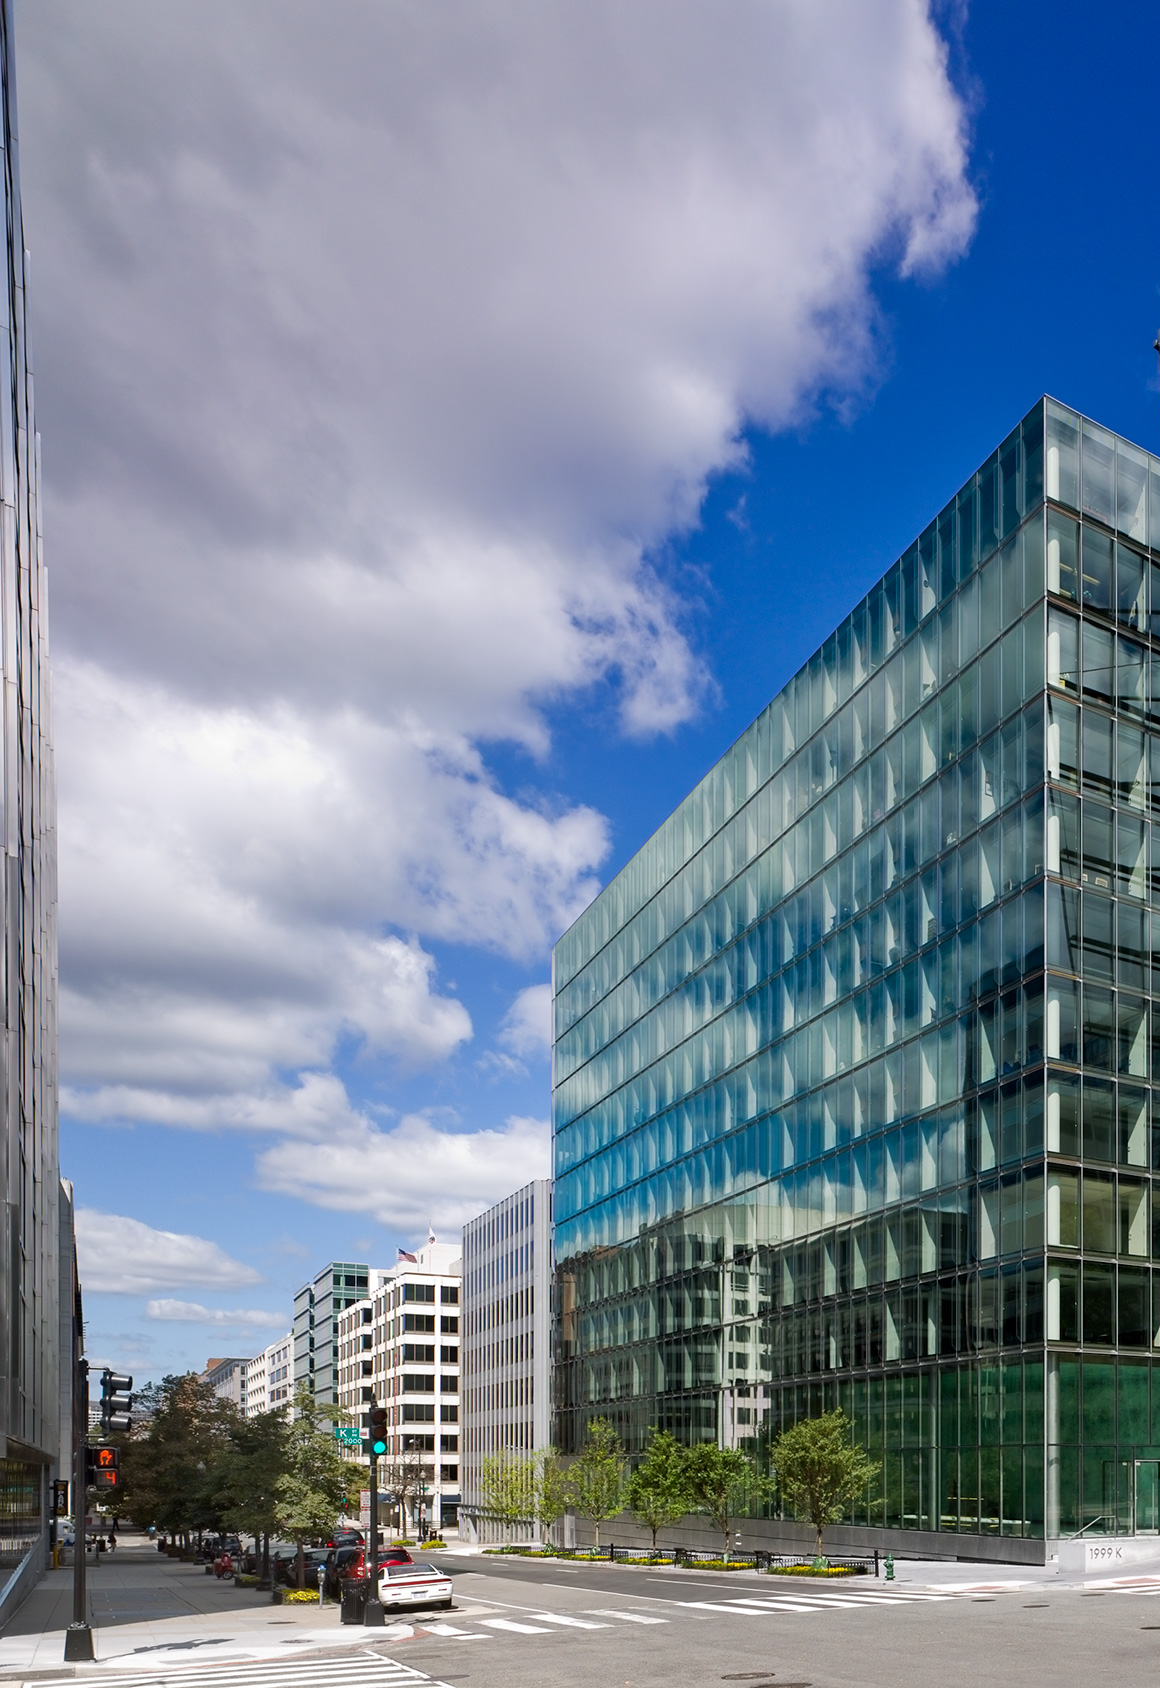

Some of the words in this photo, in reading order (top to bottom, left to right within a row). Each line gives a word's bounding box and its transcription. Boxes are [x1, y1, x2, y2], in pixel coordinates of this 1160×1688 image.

[340, 1429, 347, 1437] K
[106, 1471, 116, 1485] 4
[1089, 1547, 1113, 1559] 1999
[1115, 1547, 1122, 1558] K
